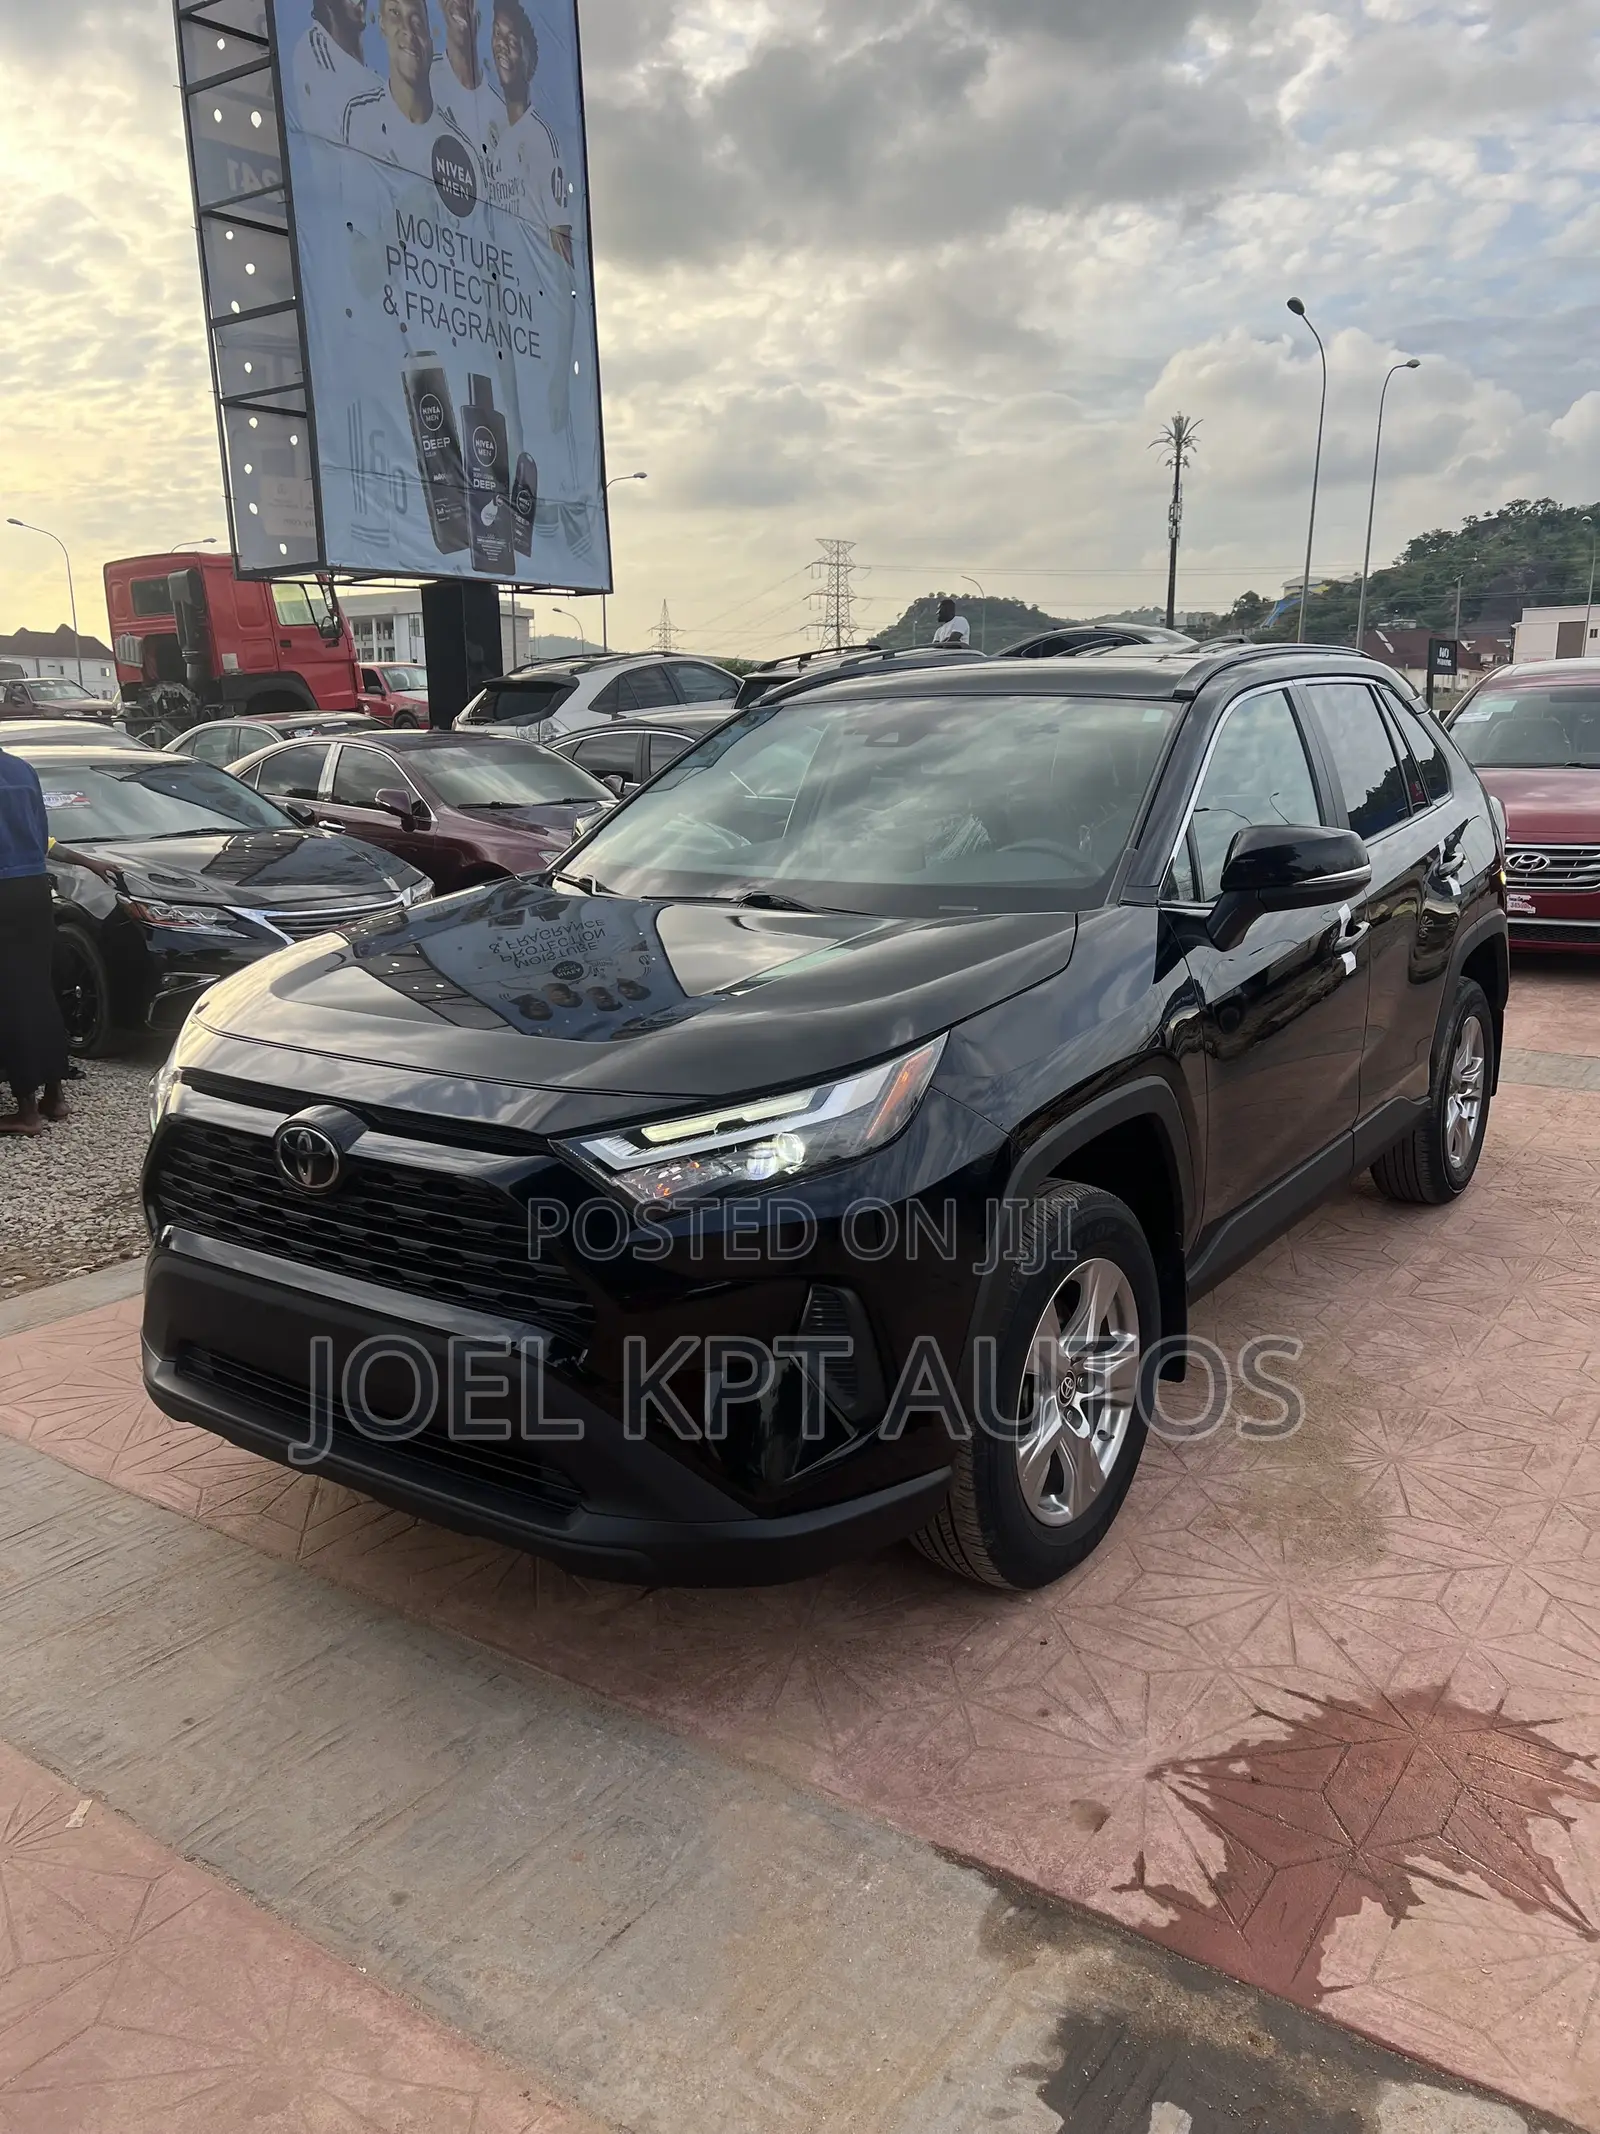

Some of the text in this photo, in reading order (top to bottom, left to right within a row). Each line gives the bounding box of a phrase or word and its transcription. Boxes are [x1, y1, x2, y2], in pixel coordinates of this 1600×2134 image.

[436, 157, 473, 186] NIVEA
[442, 178, 469, 201] MEN
[395, 208, 520, 286] MOISTURE,
[386, 245, 533, 322] PROTECTION
[383, 284, 541, 359] & FRAGRANCE
[423, 406, 440, 415] NIVEA
[425, 414, 439, 422] MEN
[423, 437, 450, 451] DEEP
[475, 439, 494, 450] NIVEA
[478, 448, 492, 457] MEN
[473, 479, 496, 490] DEEP
[1439, 647, 1450, 658] NO
